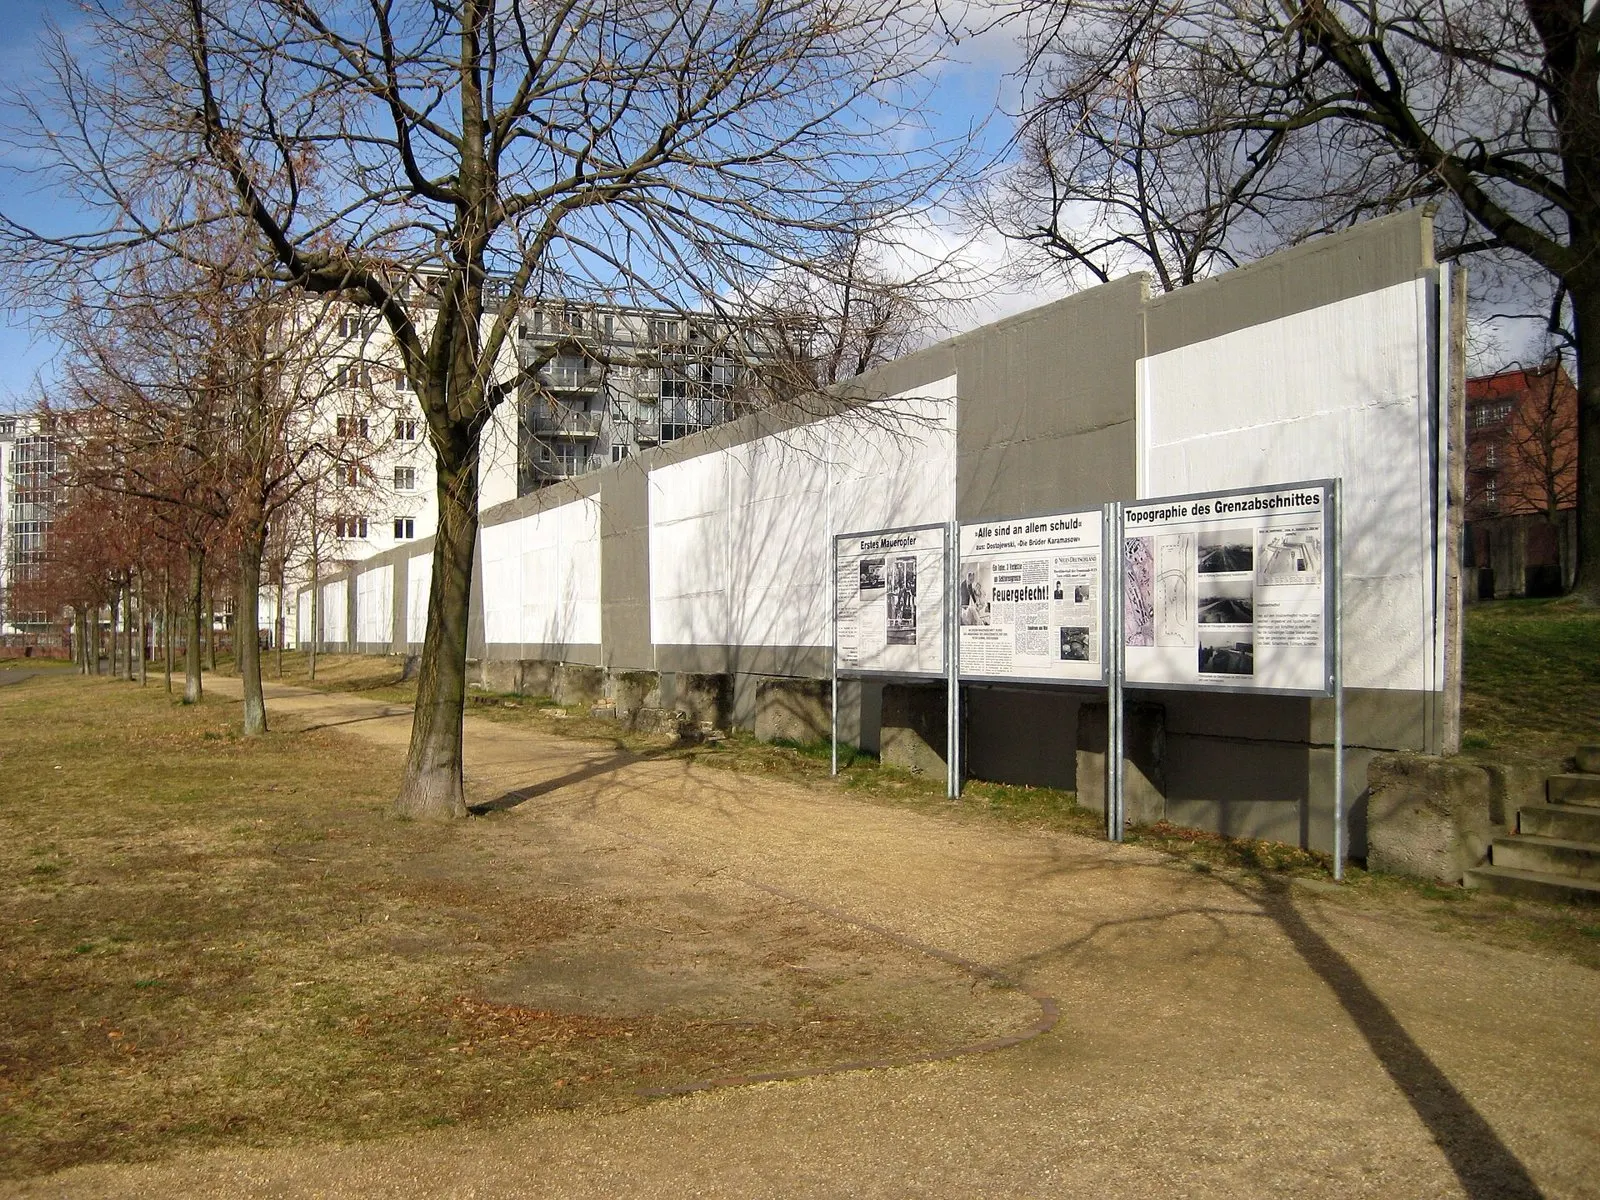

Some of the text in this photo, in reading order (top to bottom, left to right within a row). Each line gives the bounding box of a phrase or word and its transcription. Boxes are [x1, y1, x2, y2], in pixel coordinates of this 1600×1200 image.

[1125, 492, 1320, 523] Topographie des Grenzabschnittes
[994, 524, 1011, 537] sind
[1012, 526, 1023, 535] an
[1025, 522, 1047, 534] allem
[861, 536, 917, 550] Erstes Maueropfer
[1029, 538, 1046, 546] Brüder
[992, 584, 1049, 602] Feuergefecht!
